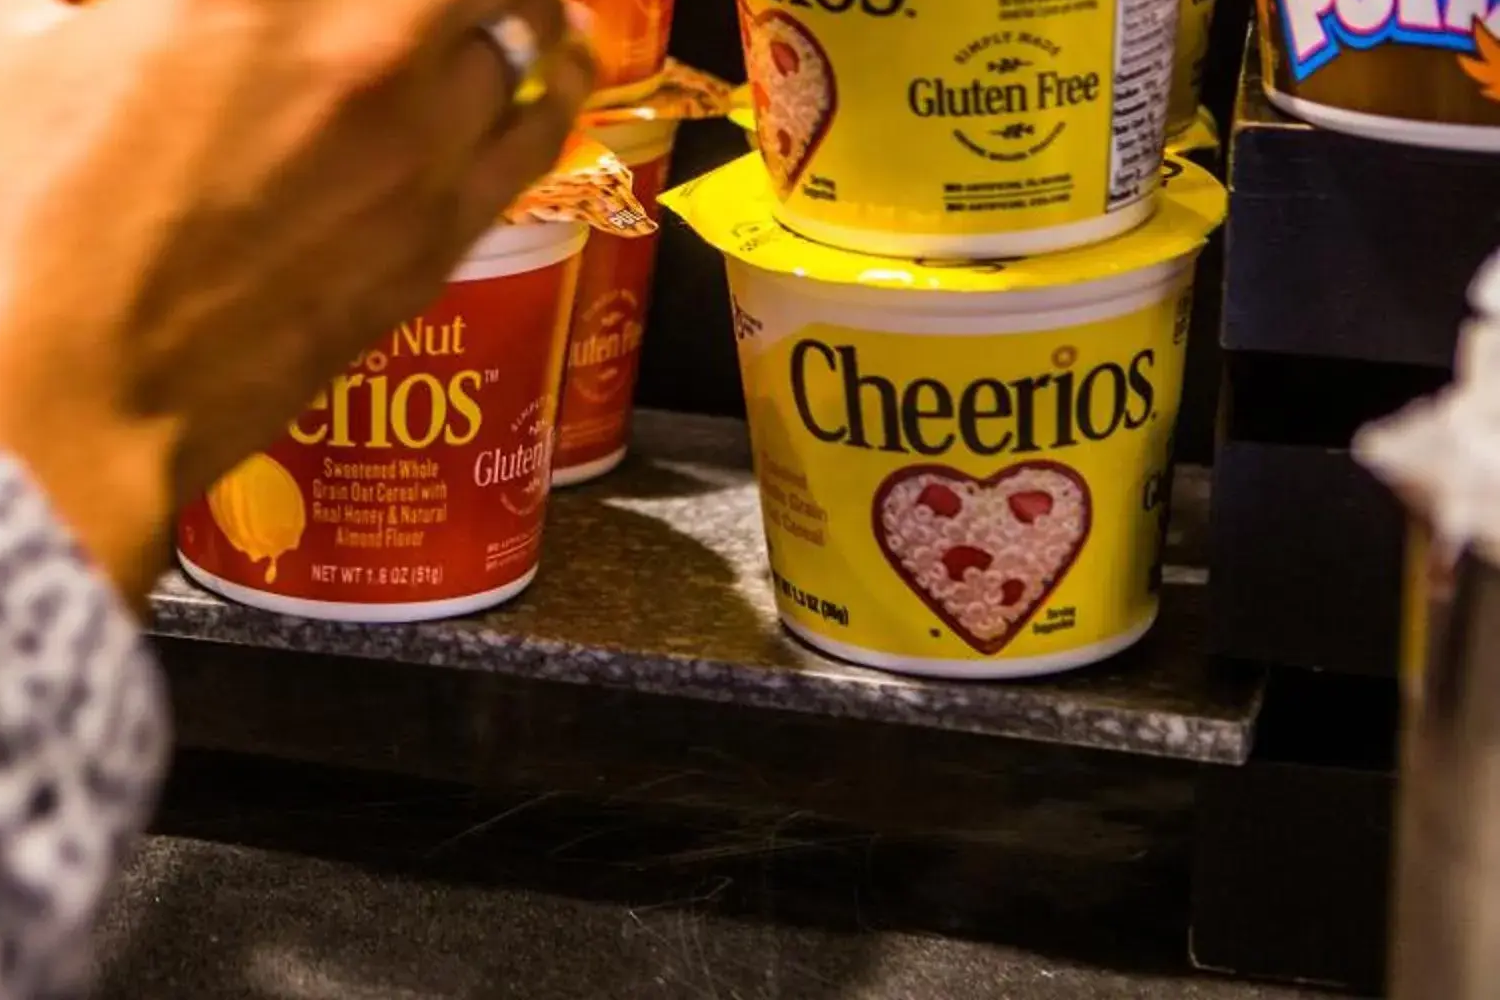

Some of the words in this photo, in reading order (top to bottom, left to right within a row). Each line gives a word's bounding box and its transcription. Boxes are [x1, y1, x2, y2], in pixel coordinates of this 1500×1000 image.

[907, 77, 1029, 118] Gluten
[1035, 70, 1101, 111] Free
[393, 313, 466, 358] Nut
[789, 339, 1155, 456] Cheerios
[323, 456, 396, 479] Sweetened
[399, 458, 440, 479] Whole
[473, 439, 545, 488] Gluten
[313, 478, 349, 500] Grain
[351, 481, 374, 502] Oat
[376, 481, 419, 502] Cereal
[421, 480, 448, 500] with
[312, 501, 341, 523] Real
[344, 503, 383, 531] Honey
[387, 504, 398, 525] &
[400, 502, 447, 524] Natural
[335, 525, 383, 548] Almond
[385, 527, 425, 548] Flavor
[311, 564, 338, 583] NET
[340, 566, 364, 584] WT
[390, 566, 409, 585] OZ
